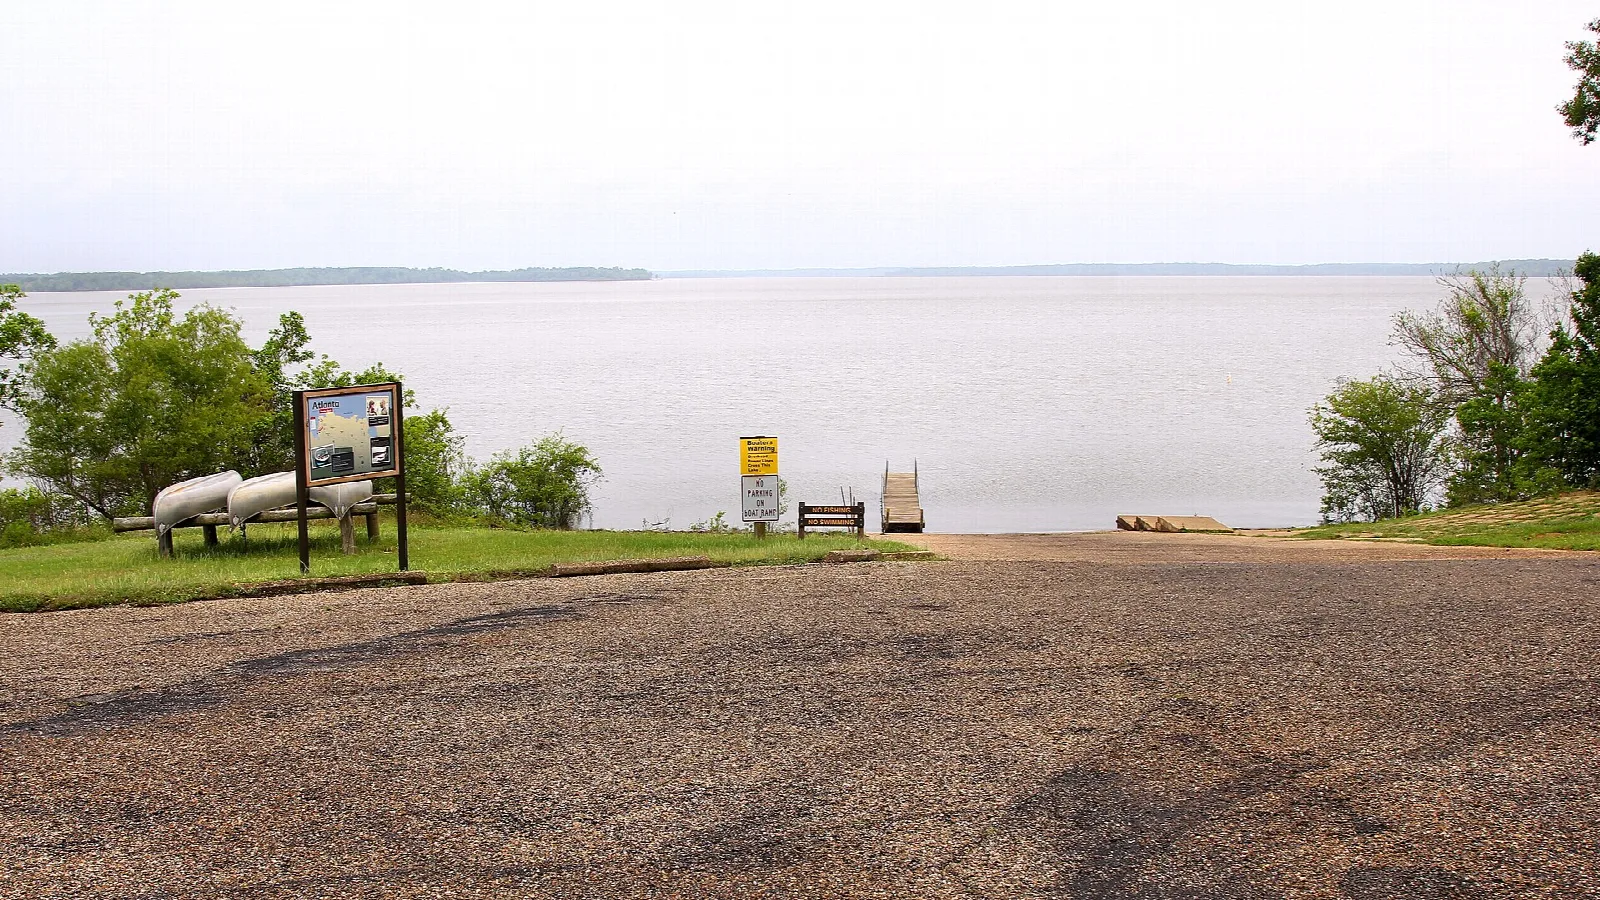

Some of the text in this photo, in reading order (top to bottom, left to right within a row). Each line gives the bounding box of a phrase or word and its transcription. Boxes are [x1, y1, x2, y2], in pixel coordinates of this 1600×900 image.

[312, 401, 340, 410] Atlanta
[755, 480, 764, 488] NO
[747, 489, 773, 497] PARKING
